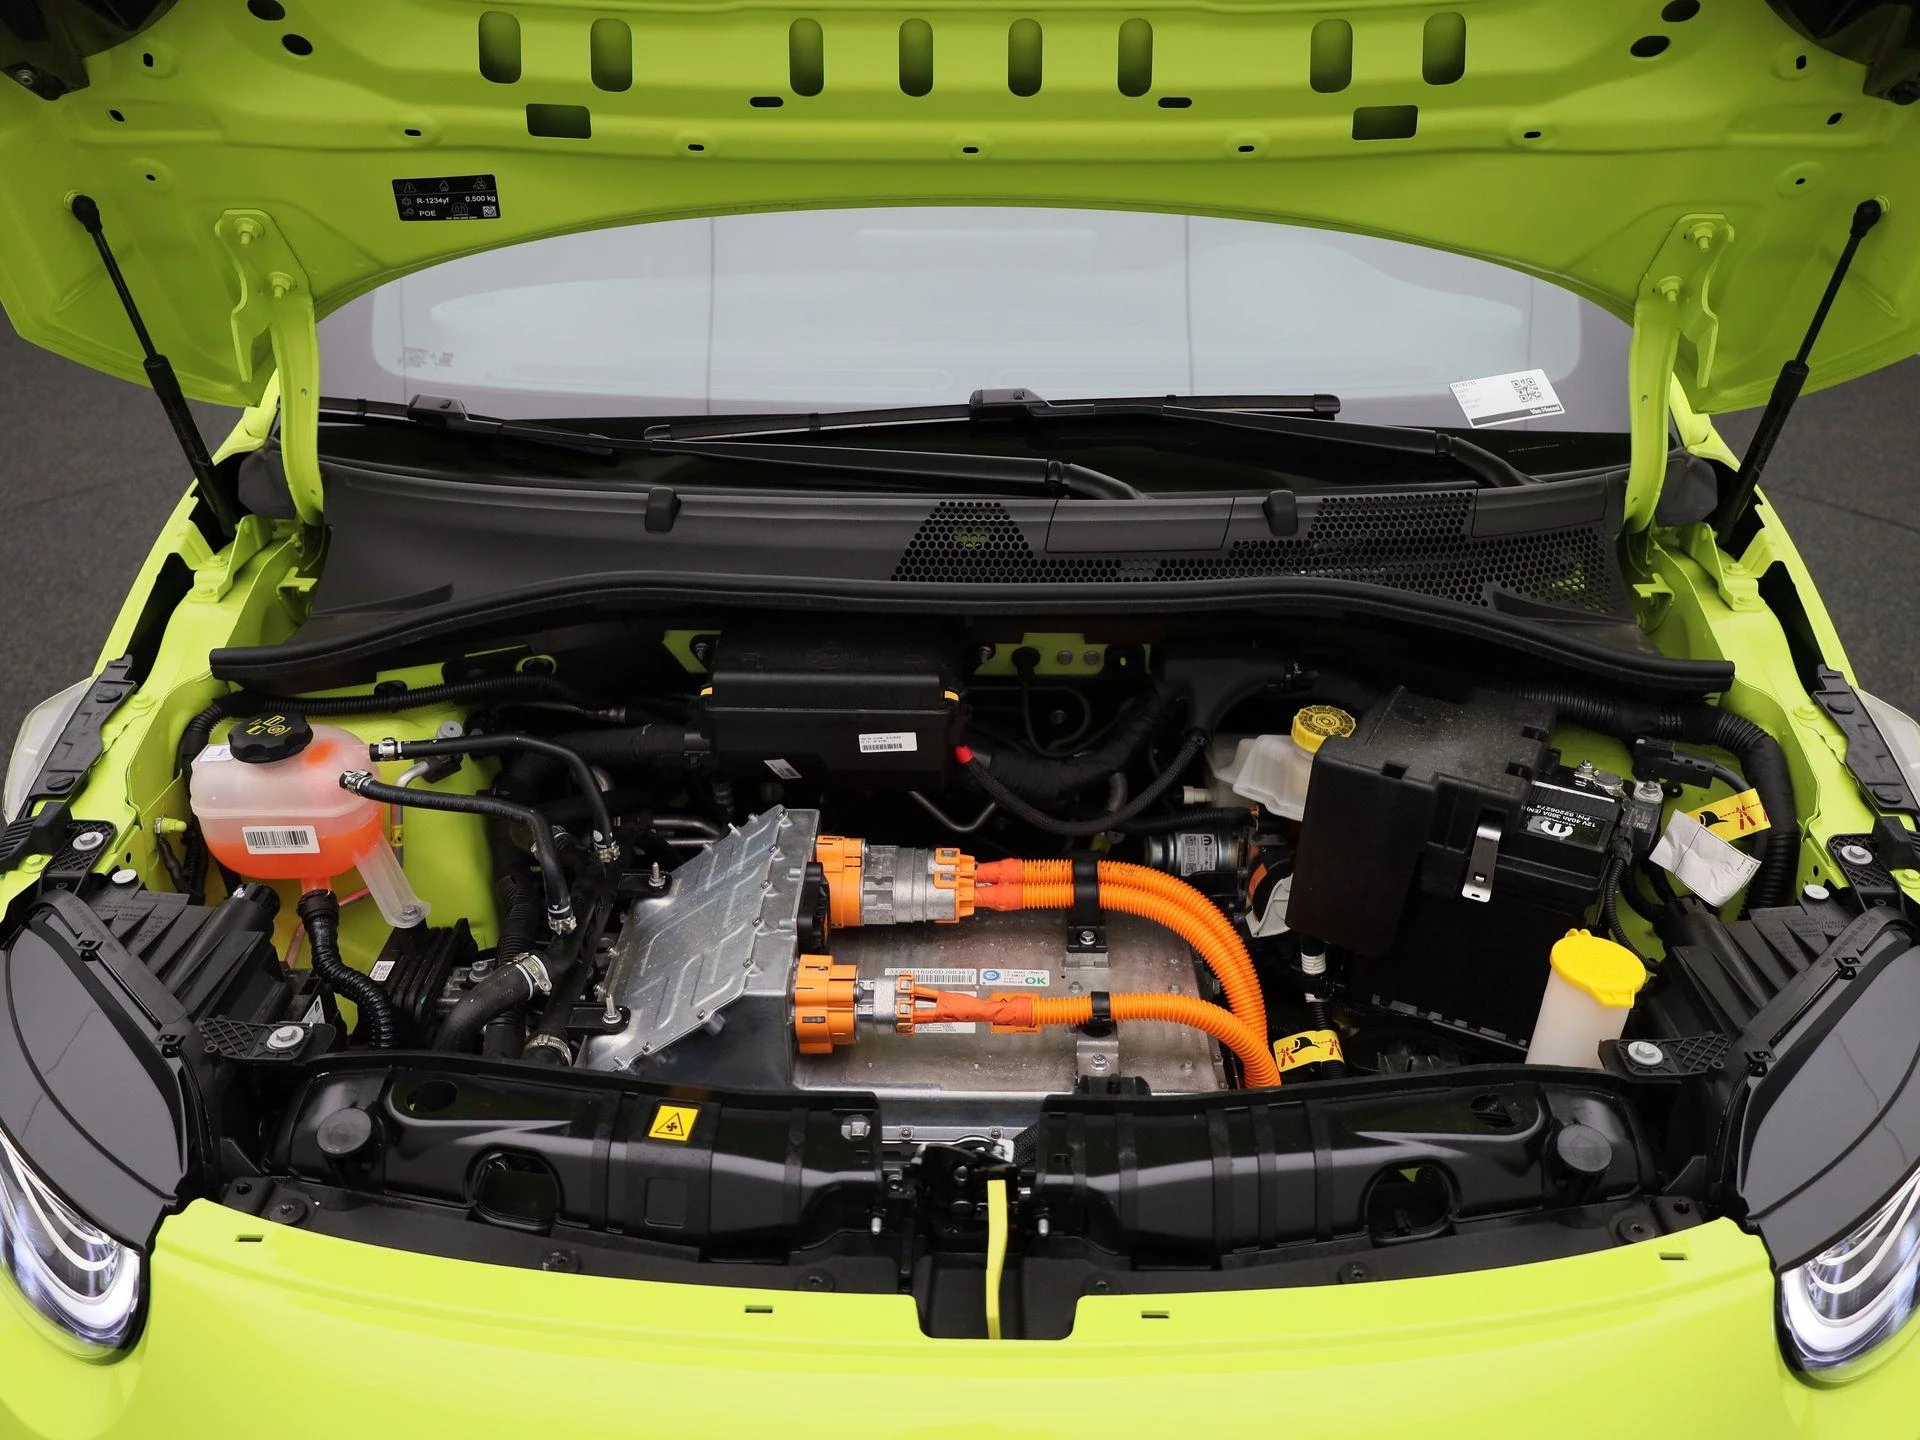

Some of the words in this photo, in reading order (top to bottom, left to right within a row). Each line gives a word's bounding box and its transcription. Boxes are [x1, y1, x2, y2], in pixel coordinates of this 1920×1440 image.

[487, 195, 496, 203] kg
[1582, 820, 1596, 828] 12V
[1025, 977, 1046, 985] OK
